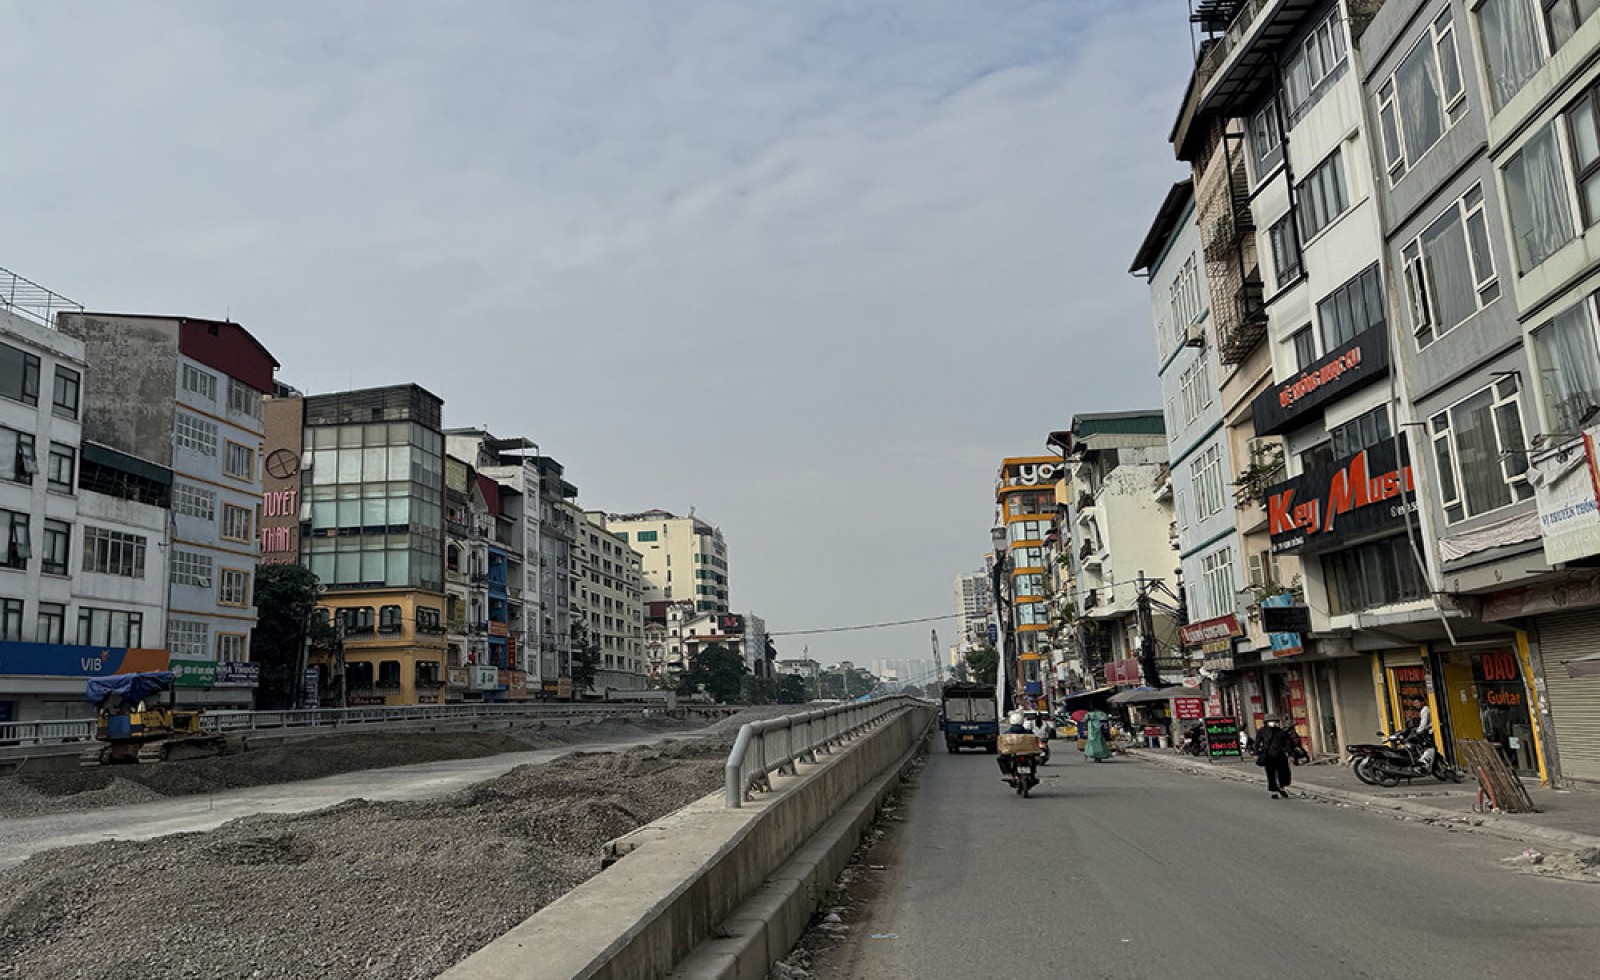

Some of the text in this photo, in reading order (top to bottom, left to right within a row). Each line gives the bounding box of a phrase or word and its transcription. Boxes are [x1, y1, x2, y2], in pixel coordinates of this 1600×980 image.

[263, 485, 297, 516] TUYẾT
[1269, 489, 1320, 535] Key
[81, 657, 102, 671] VIB
[1487, 690, 1521, 705] Guitar
